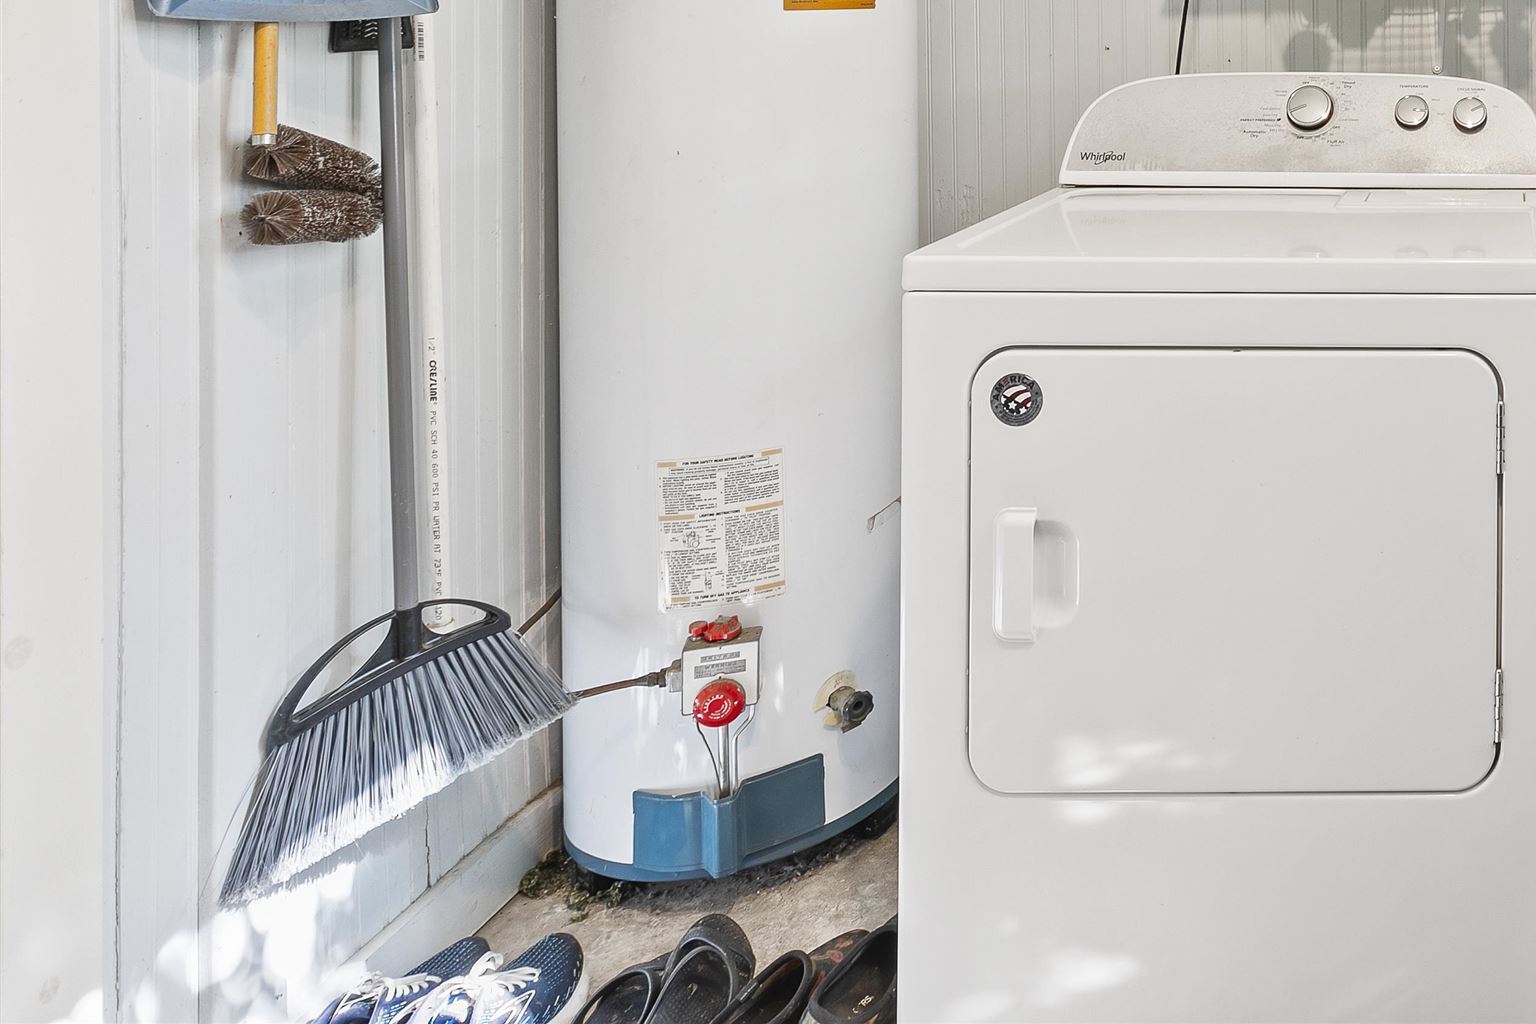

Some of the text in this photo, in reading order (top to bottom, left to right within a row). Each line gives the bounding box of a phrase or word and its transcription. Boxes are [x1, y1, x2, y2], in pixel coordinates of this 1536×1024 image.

[1080, 151, 1126, 165] Whirlpool
[992, 374, 1035, 401] AMERICA
[432, 449, 438, 459] 40
[433, 501, 440, 512] PR
[434, 544, 441, 553] AT
